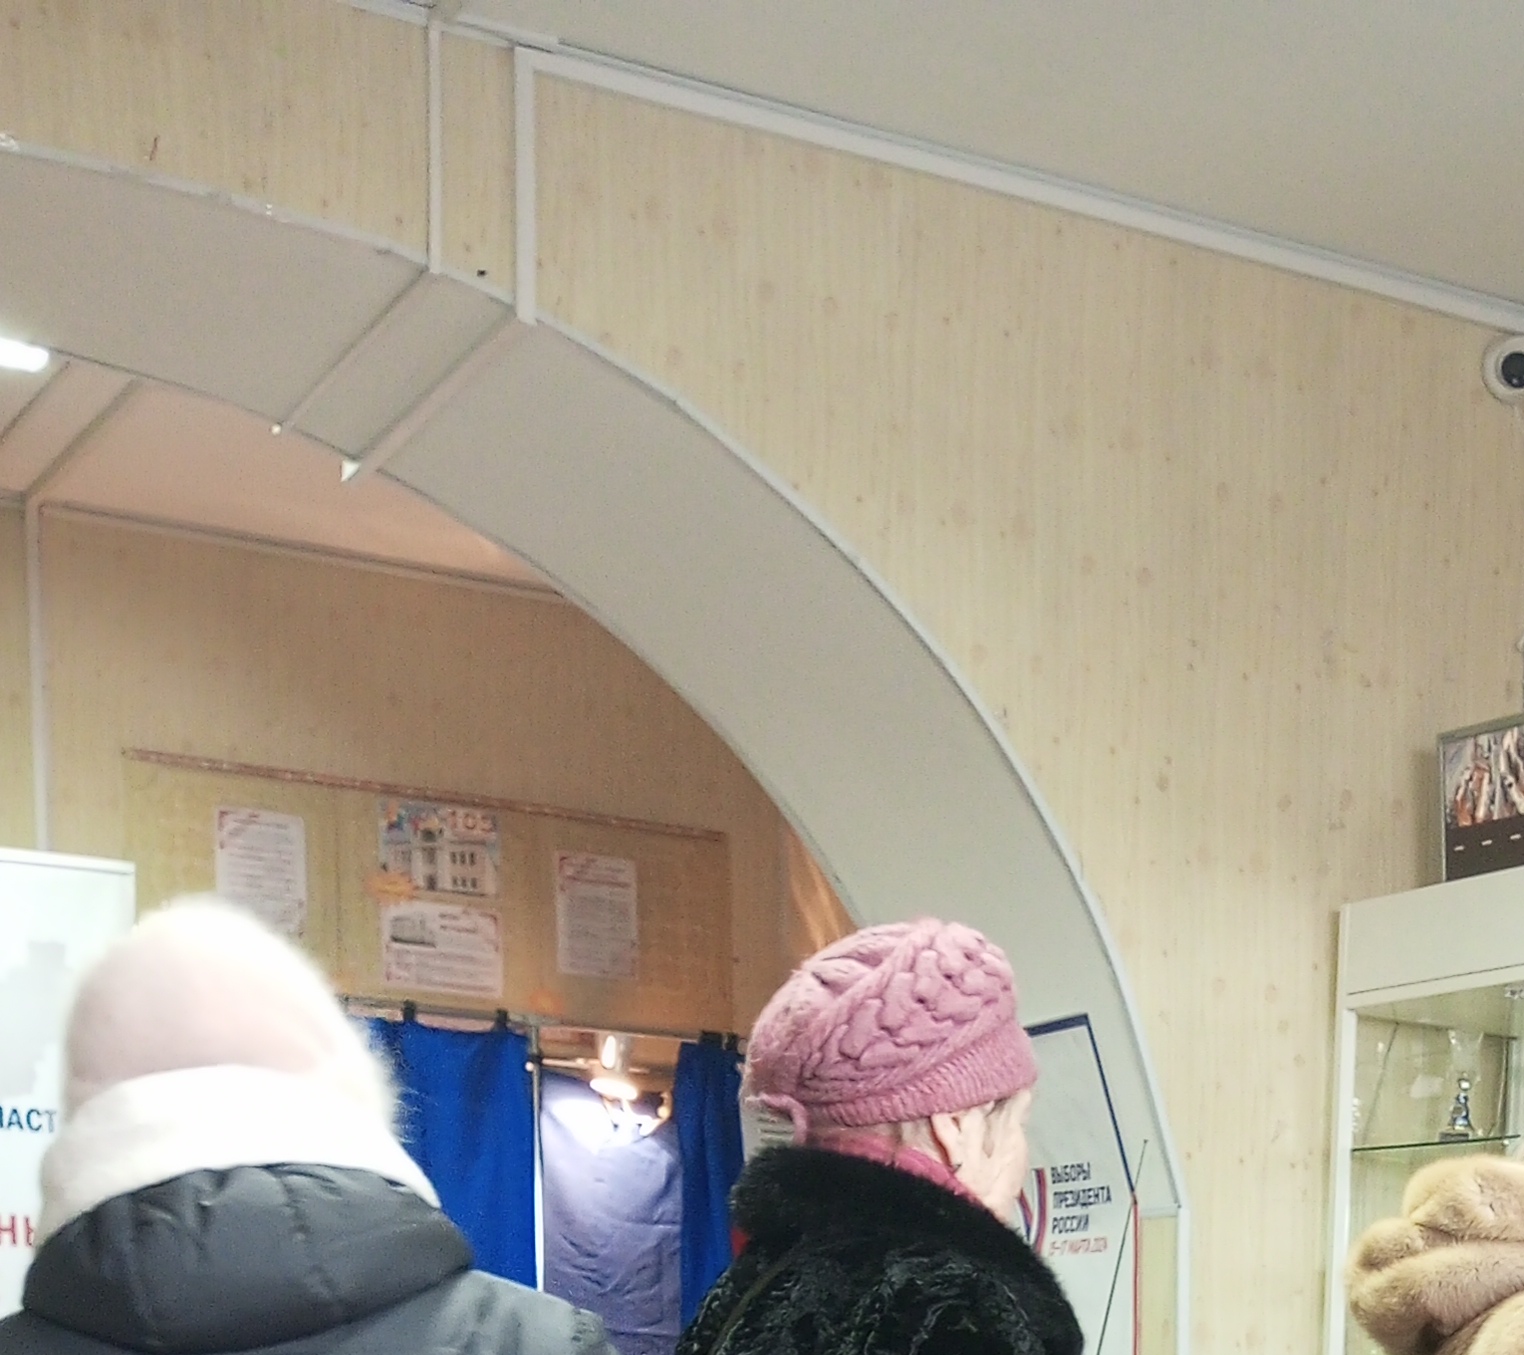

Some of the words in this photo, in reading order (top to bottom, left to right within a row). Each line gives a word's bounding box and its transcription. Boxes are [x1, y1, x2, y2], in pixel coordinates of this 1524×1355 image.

[1051, 1162, 1091, 1184] ВЫБОРЫ
[1053, 1186, 1111, 1209] ПРЕЗИДЕНТА
[1052, 1213, 1089, 1234] РОССИИ
